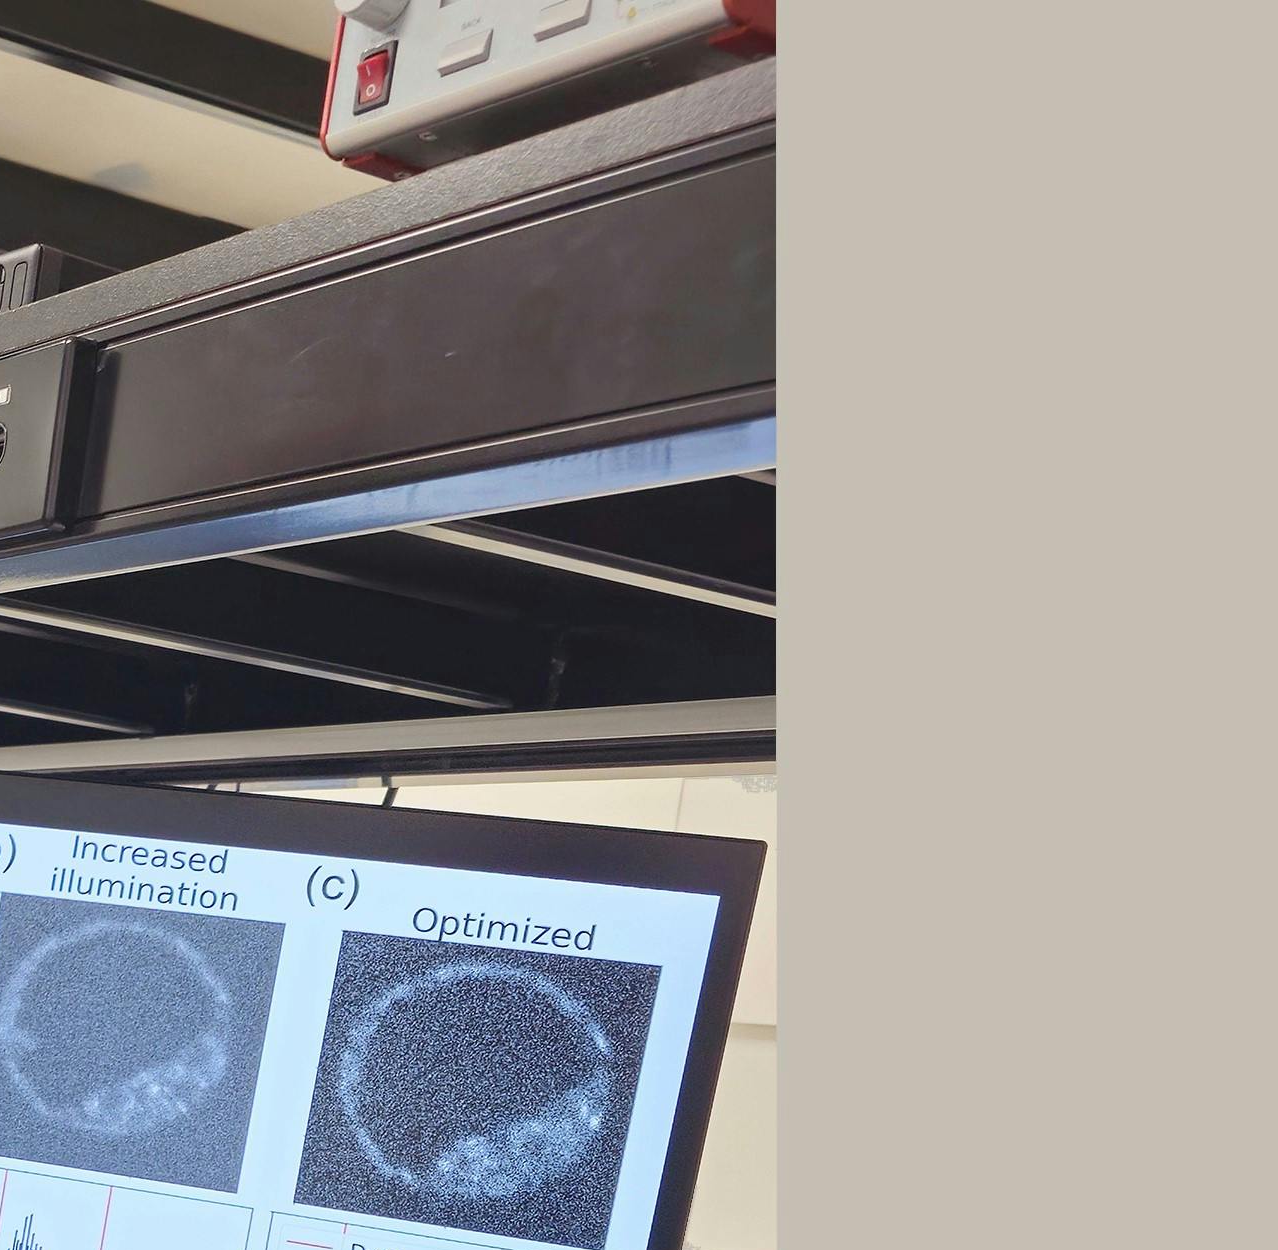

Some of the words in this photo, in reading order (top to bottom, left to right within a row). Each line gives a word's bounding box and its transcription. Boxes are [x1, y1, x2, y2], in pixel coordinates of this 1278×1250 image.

[72, 834, 228, 875] Increased
[50, 865, 239, 912] illumination
[306, 866, 360, 910] (c)
[412, 906, 597, 952] Optimized
